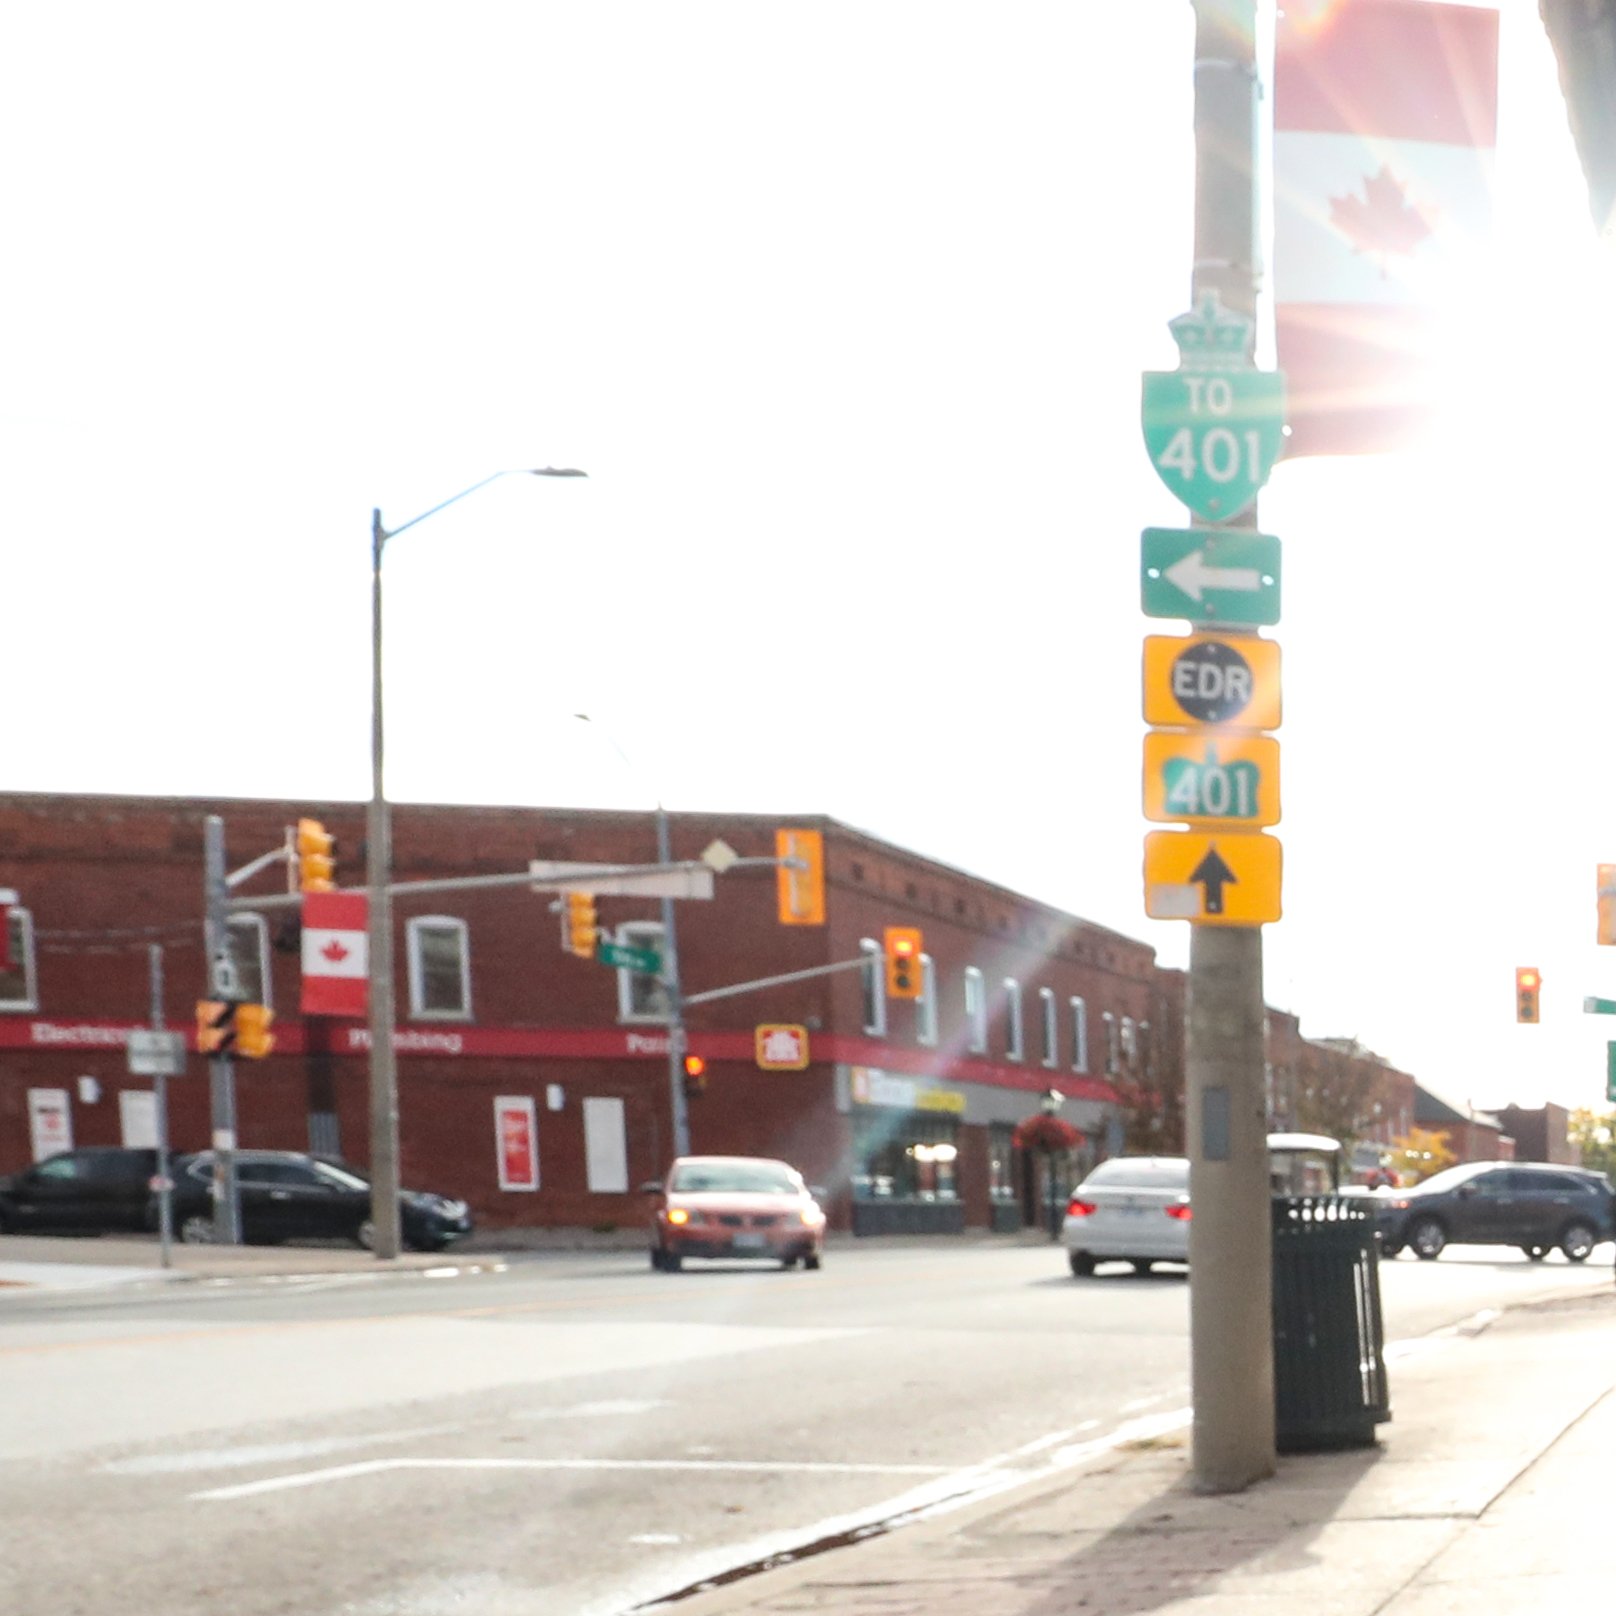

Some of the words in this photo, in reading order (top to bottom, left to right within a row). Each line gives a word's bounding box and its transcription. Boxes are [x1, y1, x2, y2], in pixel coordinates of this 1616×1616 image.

[1183, 377, 1233, 416] TO
[1158, 427, 1262, 484] 401
[1173, 660, 1251, 704] EDR
[1168, 766, 1250, 816] 401
